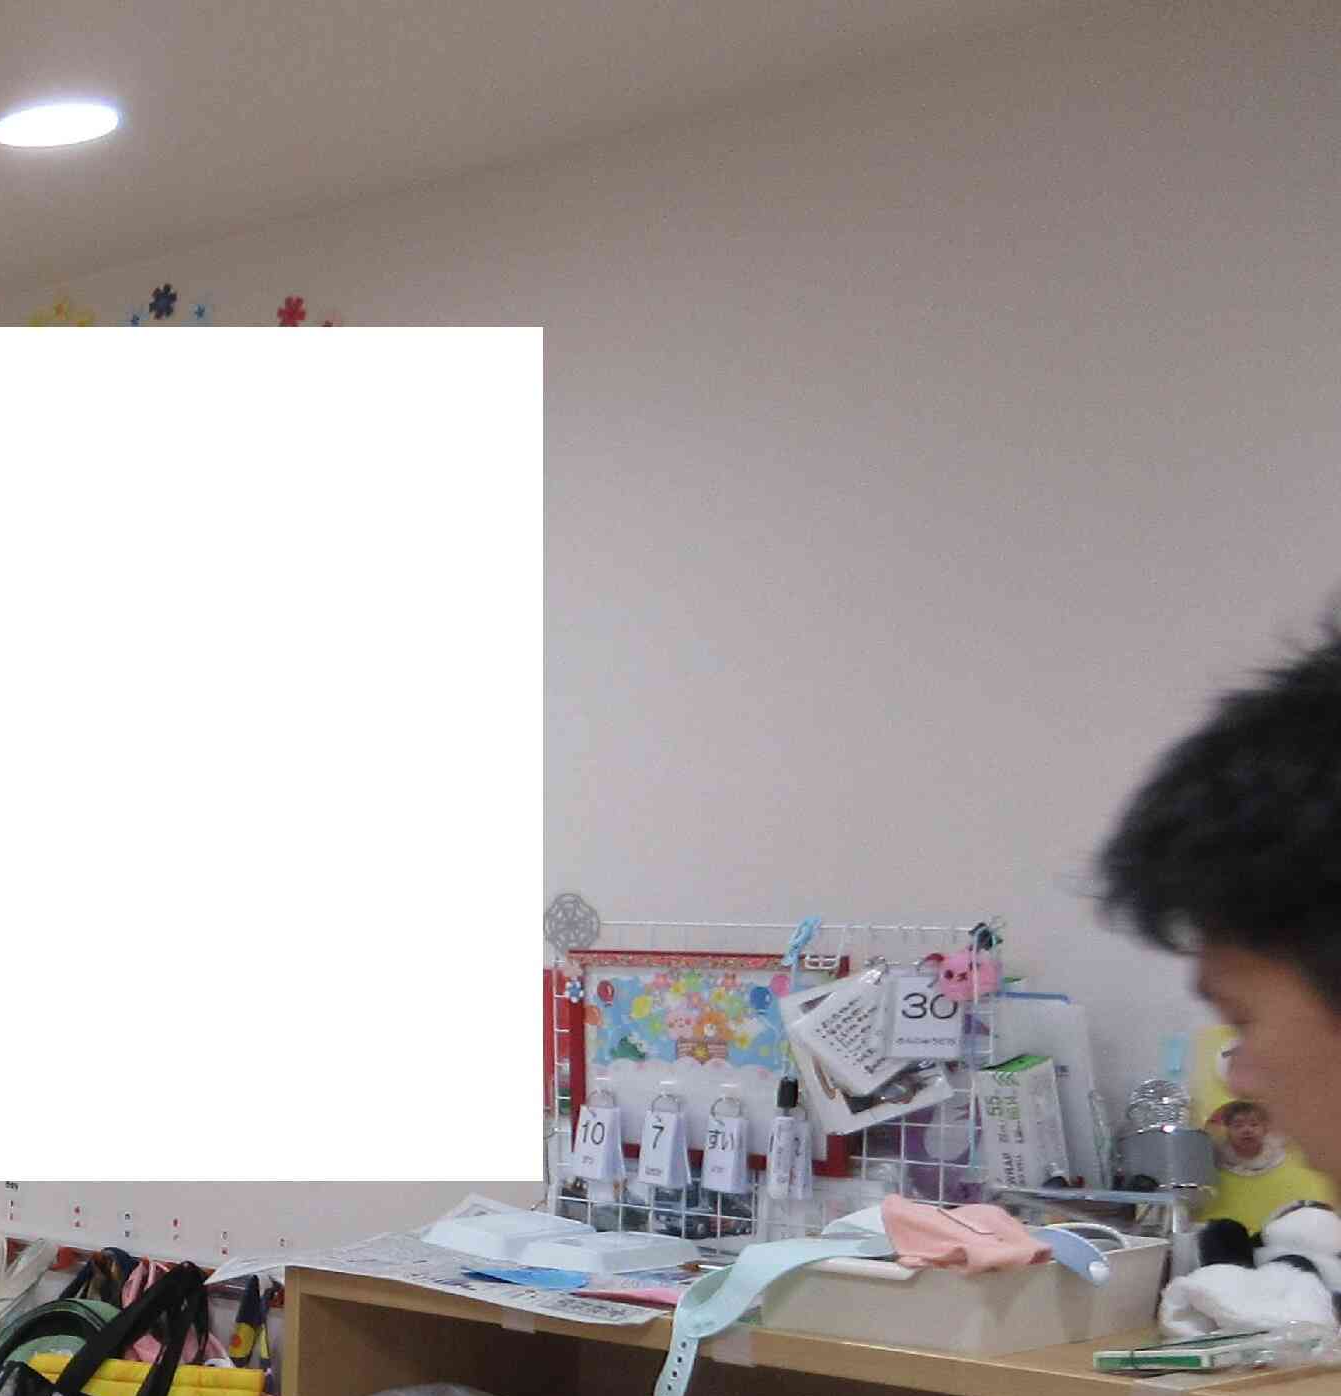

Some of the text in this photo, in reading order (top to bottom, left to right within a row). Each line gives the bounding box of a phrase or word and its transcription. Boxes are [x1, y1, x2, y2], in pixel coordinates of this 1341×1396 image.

[901, 992, 959, 1020] 30
[580, 1120, 607, 1146] 10
[651, 1124, 666, 1150] 7
